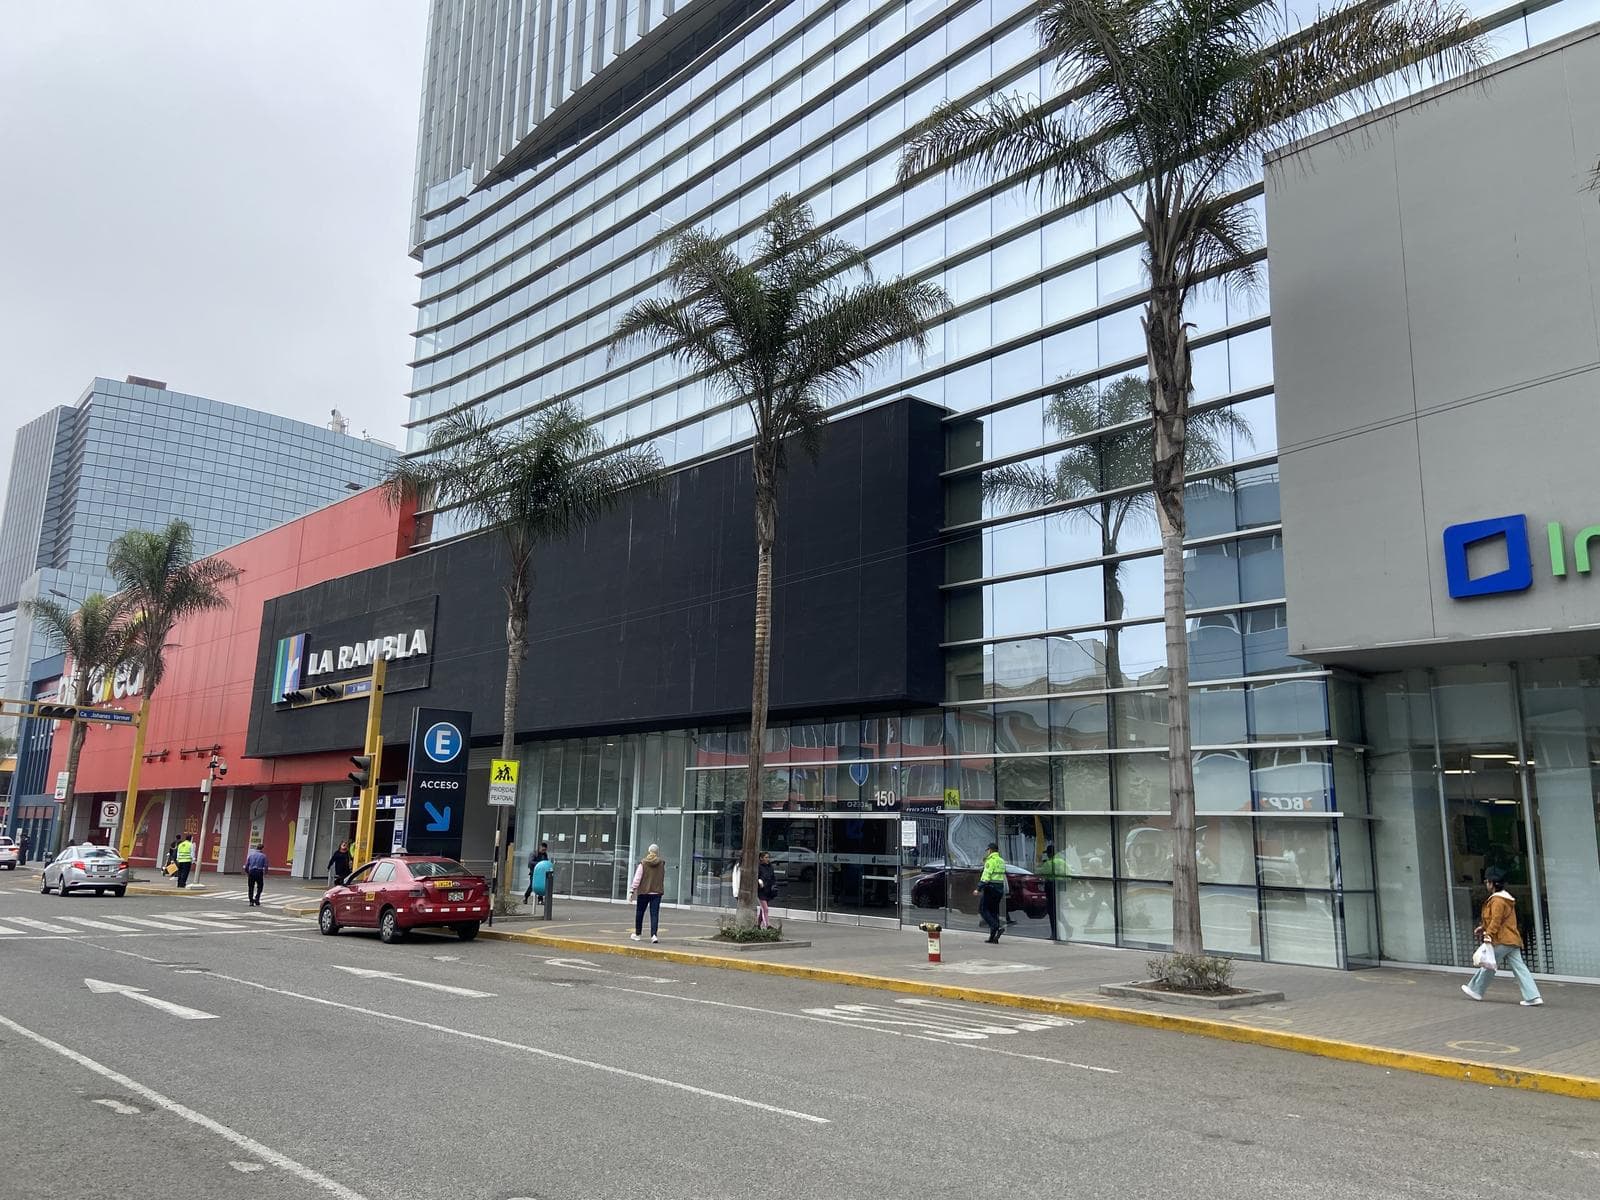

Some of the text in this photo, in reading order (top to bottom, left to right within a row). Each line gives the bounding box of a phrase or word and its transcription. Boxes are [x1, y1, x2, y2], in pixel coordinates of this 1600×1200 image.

[308, 629, 428, 676] LA RAMBLA
[435, 730, 452, 755] E
[420, 780, 459, 790] ACCESO
[874, 791, 895, 807] 150
